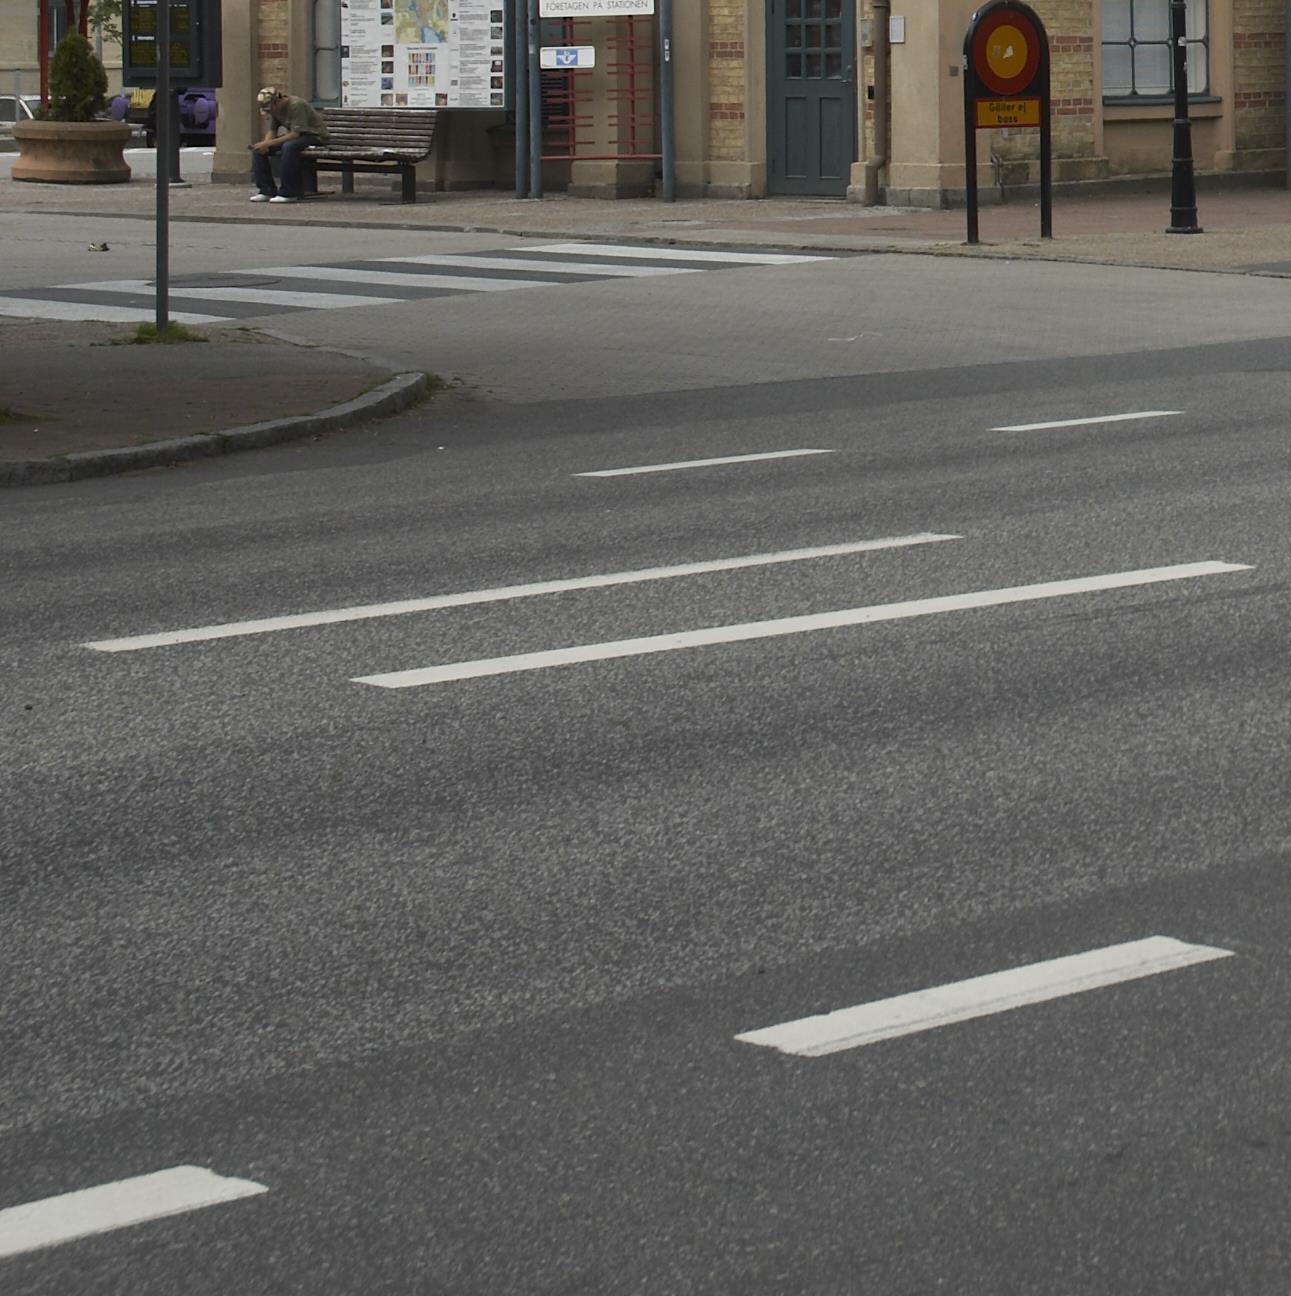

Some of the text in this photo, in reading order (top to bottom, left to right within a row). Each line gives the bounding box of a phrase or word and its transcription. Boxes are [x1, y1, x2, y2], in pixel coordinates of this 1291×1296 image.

[545, 0, 589, 11] FÖRETAGEN
[607, 0, 649, 10] STATIONEN
[989, 102, 1026, 112] Gäller ej
